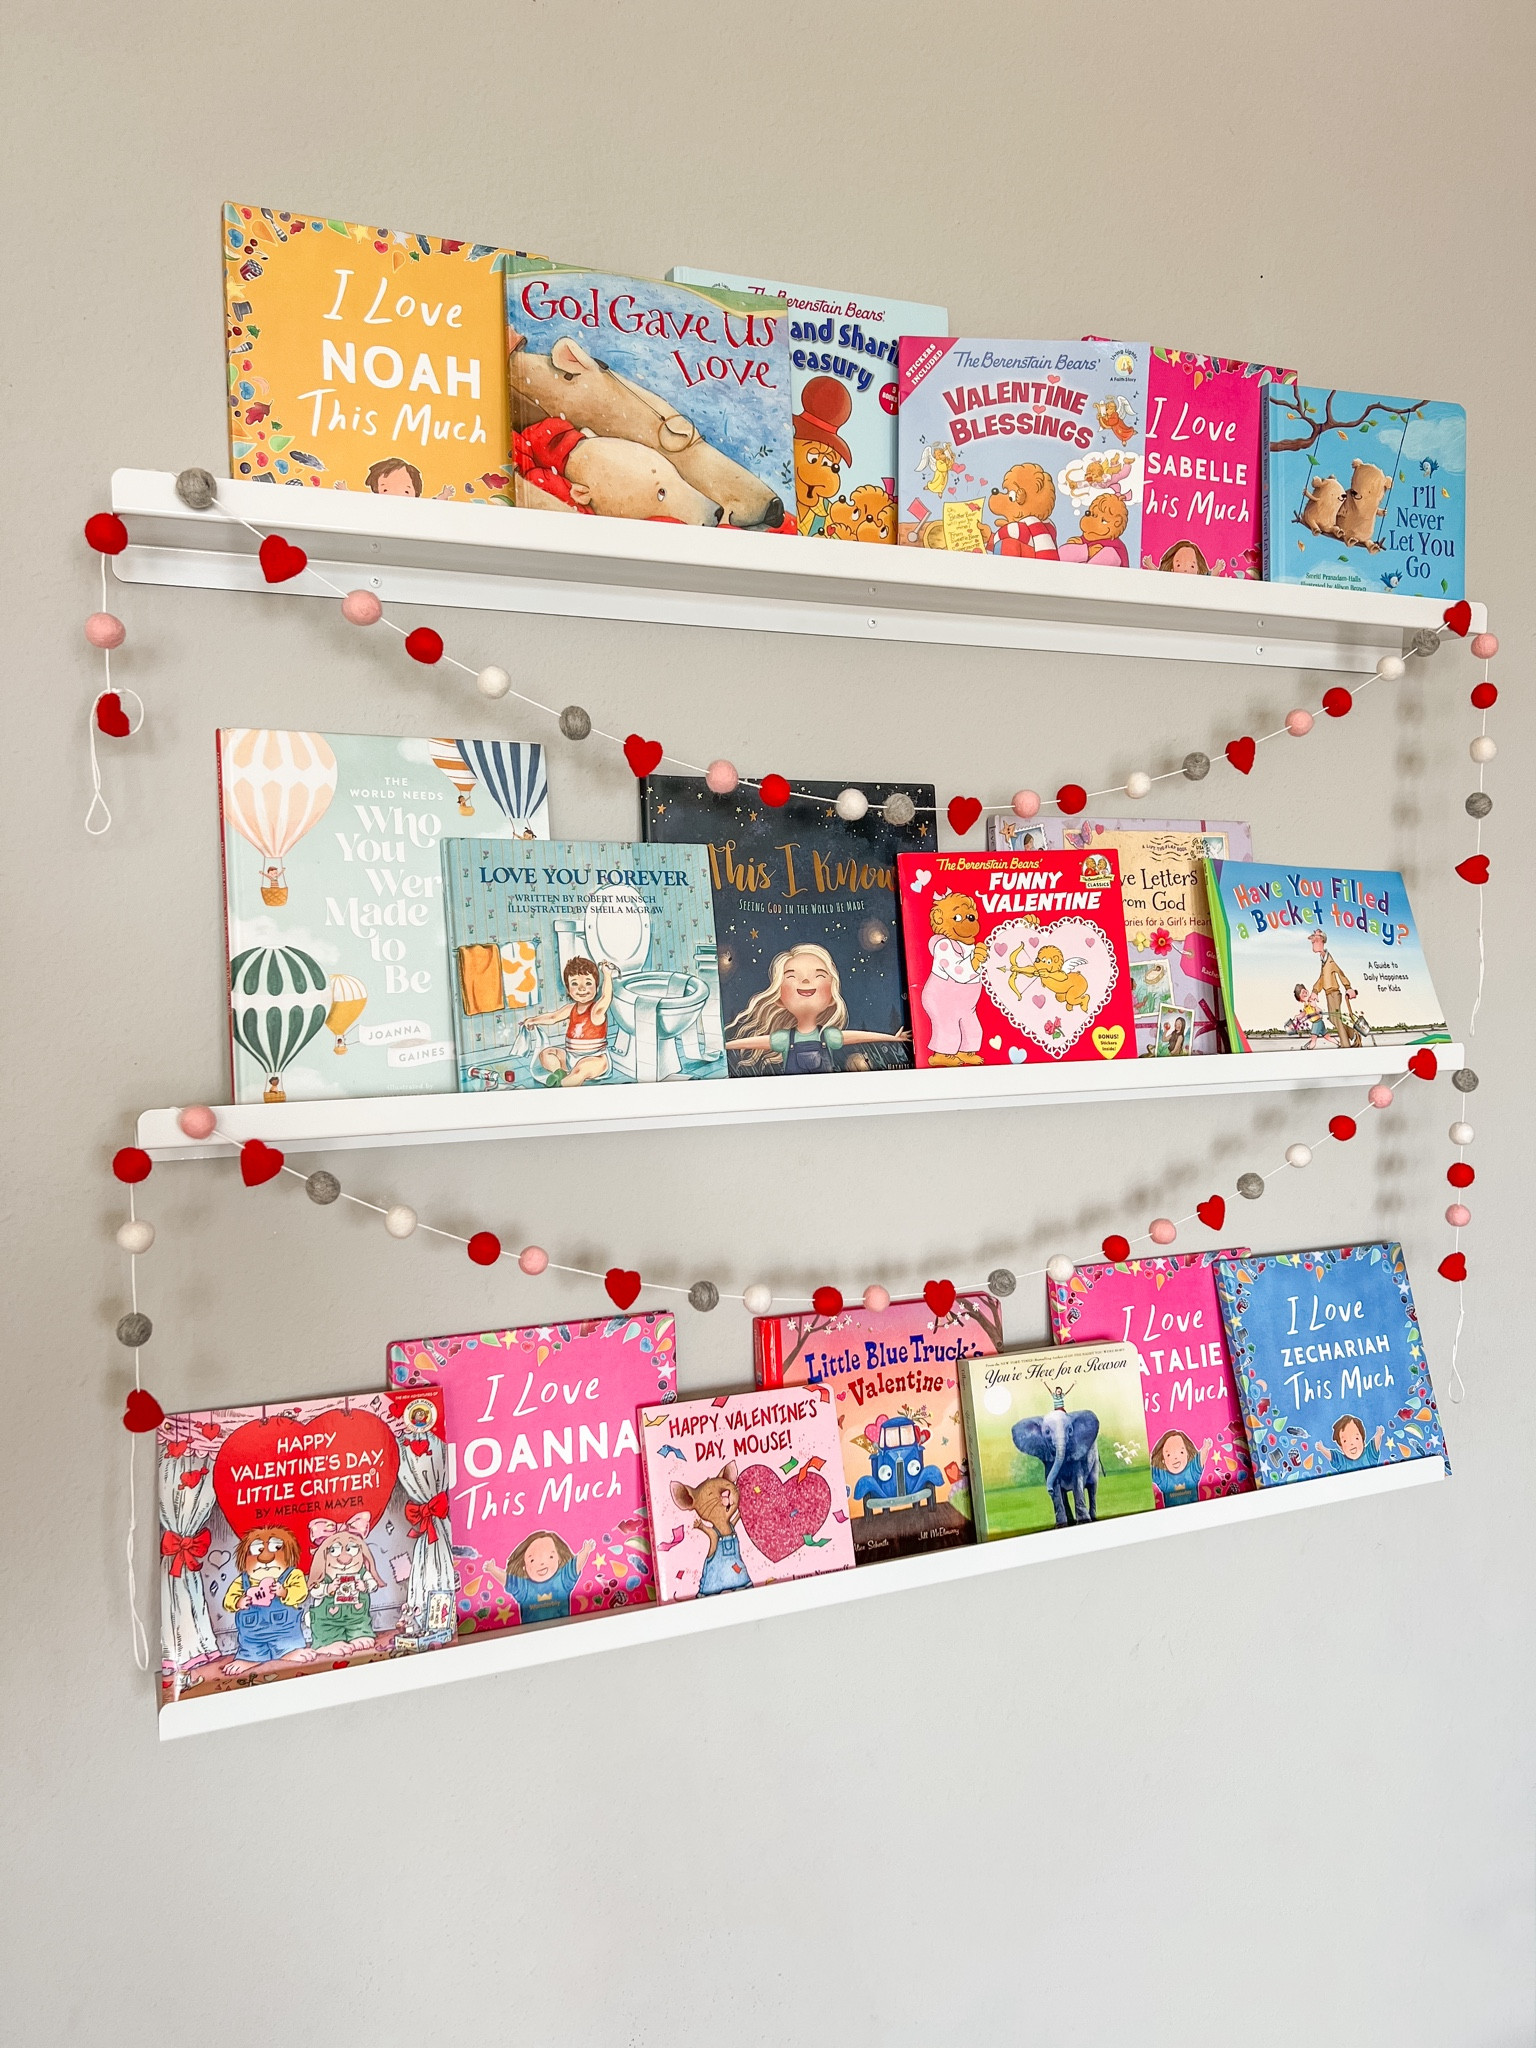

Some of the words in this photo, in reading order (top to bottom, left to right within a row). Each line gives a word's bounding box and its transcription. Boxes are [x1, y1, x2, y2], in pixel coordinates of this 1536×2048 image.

[323, 269, 355, 320] I
[363, 277, 462, 328] Love
[521, 281, 600, 329] God
[608, 294, 716, 345] Gave
[722, 311, 778, 348] Us
[790, 318, 834, 343] and
[838, 324, 899, 368] Shari
[322, 339, 481, 400] NOAH
[671, 349, 777, 390] Love
[791, 349, 874, 392] easury
[905, 343, 936, 378] STICKERS
[911, 349, 943, 385] INCLUDED
[953, 351, 980, 368] The
[981, 351, 1053, 369] Berenstain
[942, 381, 1089, 416] VALENTINE
[297, 388, 378, 437] This
[392, 403, 486, 446] Much
[949, 412, 1094, 449] BLESSINGS
[1145, 397, 1168, 439] I
[1170, 402, 1237, 442] Love
[1147, 452, 1248, 485] SABELLE
[1145, 484, 1180, 518] his
[1187, 490, 1249, 526] Much
[1412, 485, 1437, 510] I'll
[1396, 506, 1446, 532] Never
[1389, 529, 1415, 552] Let
[1418, 532, 1455, 558] You
[1406, 555, 1431, 579] Go
[350, 788, 395, 799] WORLD
[403, 791, 444, 801] NEEDS
[385, 776, 409, 787] THE
[353, 804, 442, 849] Who
[334, 832, 406, 863] You
[936, 858, 956, 871] The
[956, 857, 1009, 871] Berenstain
[365, 868, 443, 898] Wer
[479, 867, 538, 884] LOVE
[542, 868, 590, 885] YOU
[595, 869, 690, 886] FOREVER
[707, 840, 776, 893] This
[774, 842, 808, 898] I
[989, 871, 1063, 891] FUNNY
[1120, 874, 1136, 886] ve
[1140, 868, 1198, 890] Letters
[508, 905, 574, 914] ILLUSTRATED
[576, 905, 588, 914] BY
[590, 906, 623, 914] SHEILA
[626, 906, 664, 914] McGRAW
[514, 894, 560, 903] WRITTEN
[563, 894, 575, 903] BY
[577, 895, 613, 903] ROBERT
[616, 895, 657, 904] MUNSCH
[767, 902, 783, 914] GOD
[975, 890, 1102, 914] VALENTINE
[1122, 898, 1146, 909] rom
[1152, 891, 1186, 911] God
[1233, 880, 1283, 910] Have
[1286, 873, 1324, 899] You
[1330, 877, 1390, 916] Filled
[325, 896, 429, 939] Made
[1124, 917, 1144, 927] ories
[1146, 917, 1157, 927] for
[1166, 916, 1187, 926] Girl's
[1236, 922, 1250, 940] a
[1250, 899, 1323, 933] Bucket
[1330, 903, 1410, 946] today?
[370, 933, 406, 962] to
[385, 964, 432, 994] Be
[1363, 972, 1378, 982] Daily
[1379, 973, 1409, 981] Happiness
[1368, 961, 1373, 969] A
[1374, 961, 1390, 969] Guide
[1391, 961, 1398, 969] to
[1388, 984, 1401, 992] Kids
[368, 1025, 422, 1040] JOANNA
[398, 1047, 446, 1062] GAINES
[1143, 1304, 1204, 1342] Love
[1286, 1295, 1299, 1335] I
[1309, 1294, 1365, 1331] Love
[804, 1349, 861, 1384] Little
[864, 1341, 908, 1370] Blue
[910, 1334, 984, 1362] Truck's
[1138, 1342, 1224, 1376] ATALIE
[1280, 1334, 1391, 1367] ZECHARIAH
[848, 1369, 944, 1406] Valentine
[985, 1365, 1022, 1389] You're
[1025, 1363, 1056, 1380] Here
[1051, 1360, 1072, 1380] for
[1074, 1364, 1082, 1374] a
[1084, 1356, 1127, 1373] Reason
[1284, 1370, 1333, 1410] This
[1341, 1364, 1395, 1400] Much
[477, 1373, 505, 1423] I
[512, 1371, 600, 1417] Love
[1144, 1392, 1160, 1413] is
[1169, 1375, 1229, 1412] Much
[668, 1413, 719, 1438] HAPPY
[725, 1399, 818, 1431] VALENTINE'S
[277, 1432, 337, 1454] HAPPY
[695, 1438, 726, 1463] DAY,
[733, 1429, 793, 1457] MOUSE!
[230, 1454, 341, 1482] VALENTINE'S
[346, 1448, 385, 1469] DAY,
[236, 1482, 295, 1506] LITTLE
[256, 1506, 270, 1519] BY
[274, 1499, 321, 1516] MERCER
[324, 1496, 364, 1510] MAYER
[454, 1481, 525, 1530] This
[537, 1470, 622, 1514] Much
[255, 1587, 266, 1600] Hi
